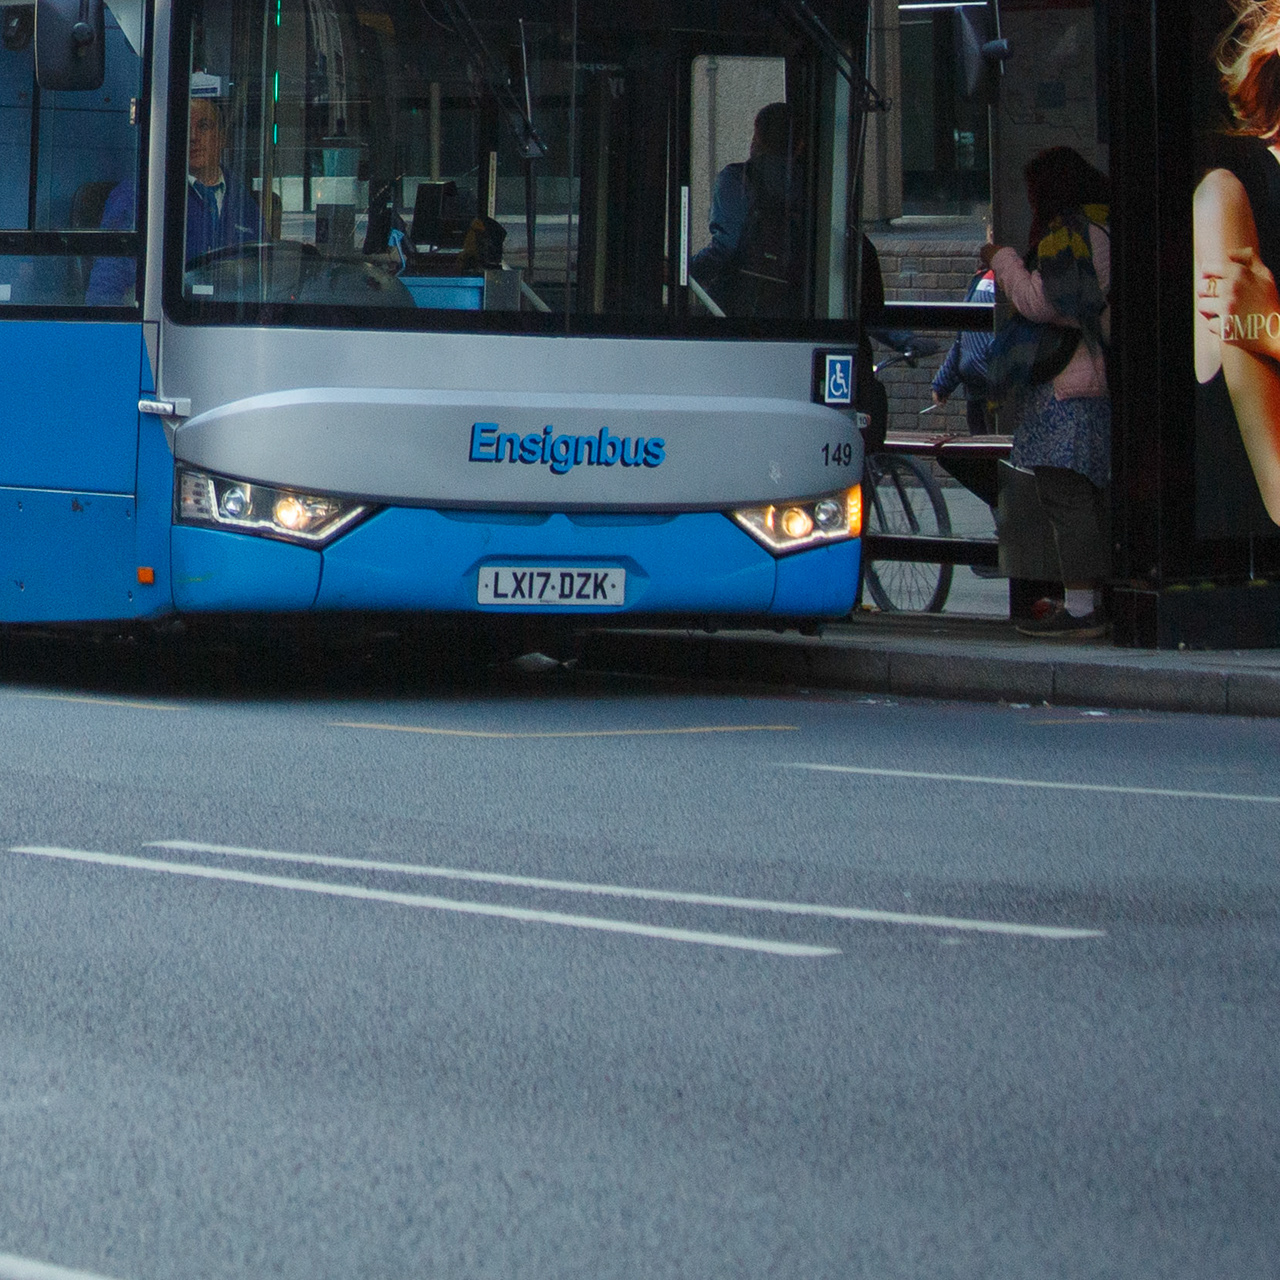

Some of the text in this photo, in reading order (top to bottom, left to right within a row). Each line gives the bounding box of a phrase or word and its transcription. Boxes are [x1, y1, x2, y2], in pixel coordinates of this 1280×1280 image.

[1219, 312, 1280, 341] EMPO
[469, 422, 666, 475] Ensignbus
[821, 443, 852, 466] 149
[493, 571, 609, 599] LX17 DZK
